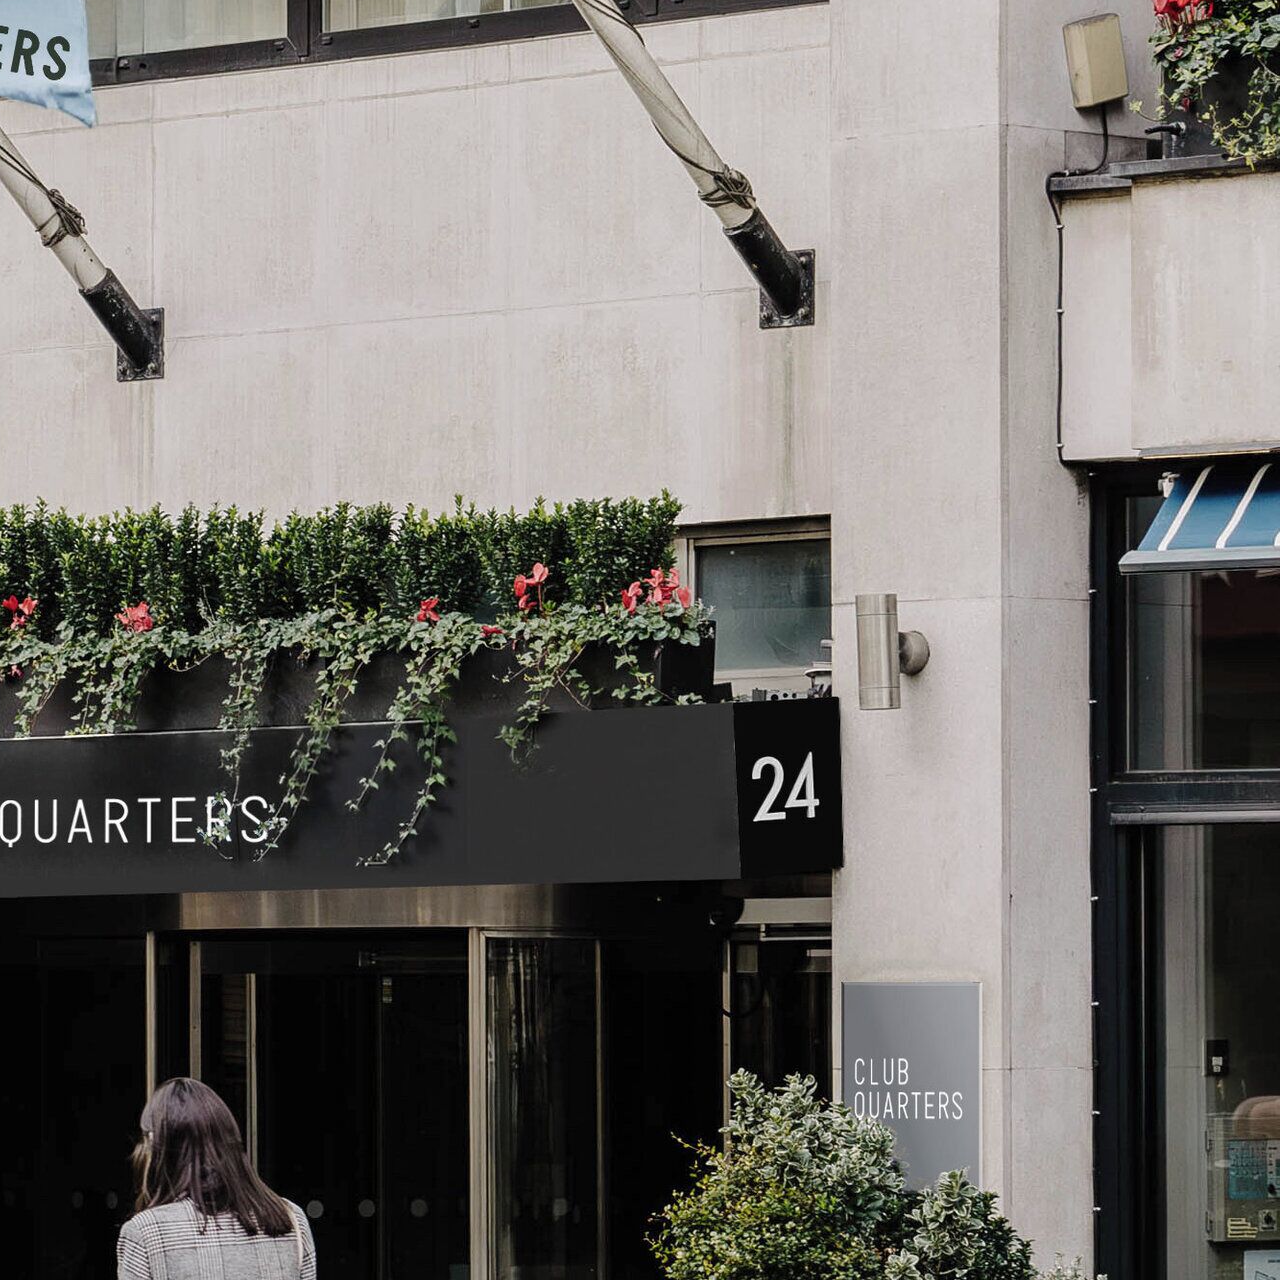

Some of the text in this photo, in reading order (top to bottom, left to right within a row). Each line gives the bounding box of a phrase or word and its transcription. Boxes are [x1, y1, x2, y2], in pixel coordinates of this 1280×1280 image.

[751, 751, 820, 822] 24
[854, 1057, 909, 1086] CLUB
[854, 1091, 963, 1120] QUARTERS
